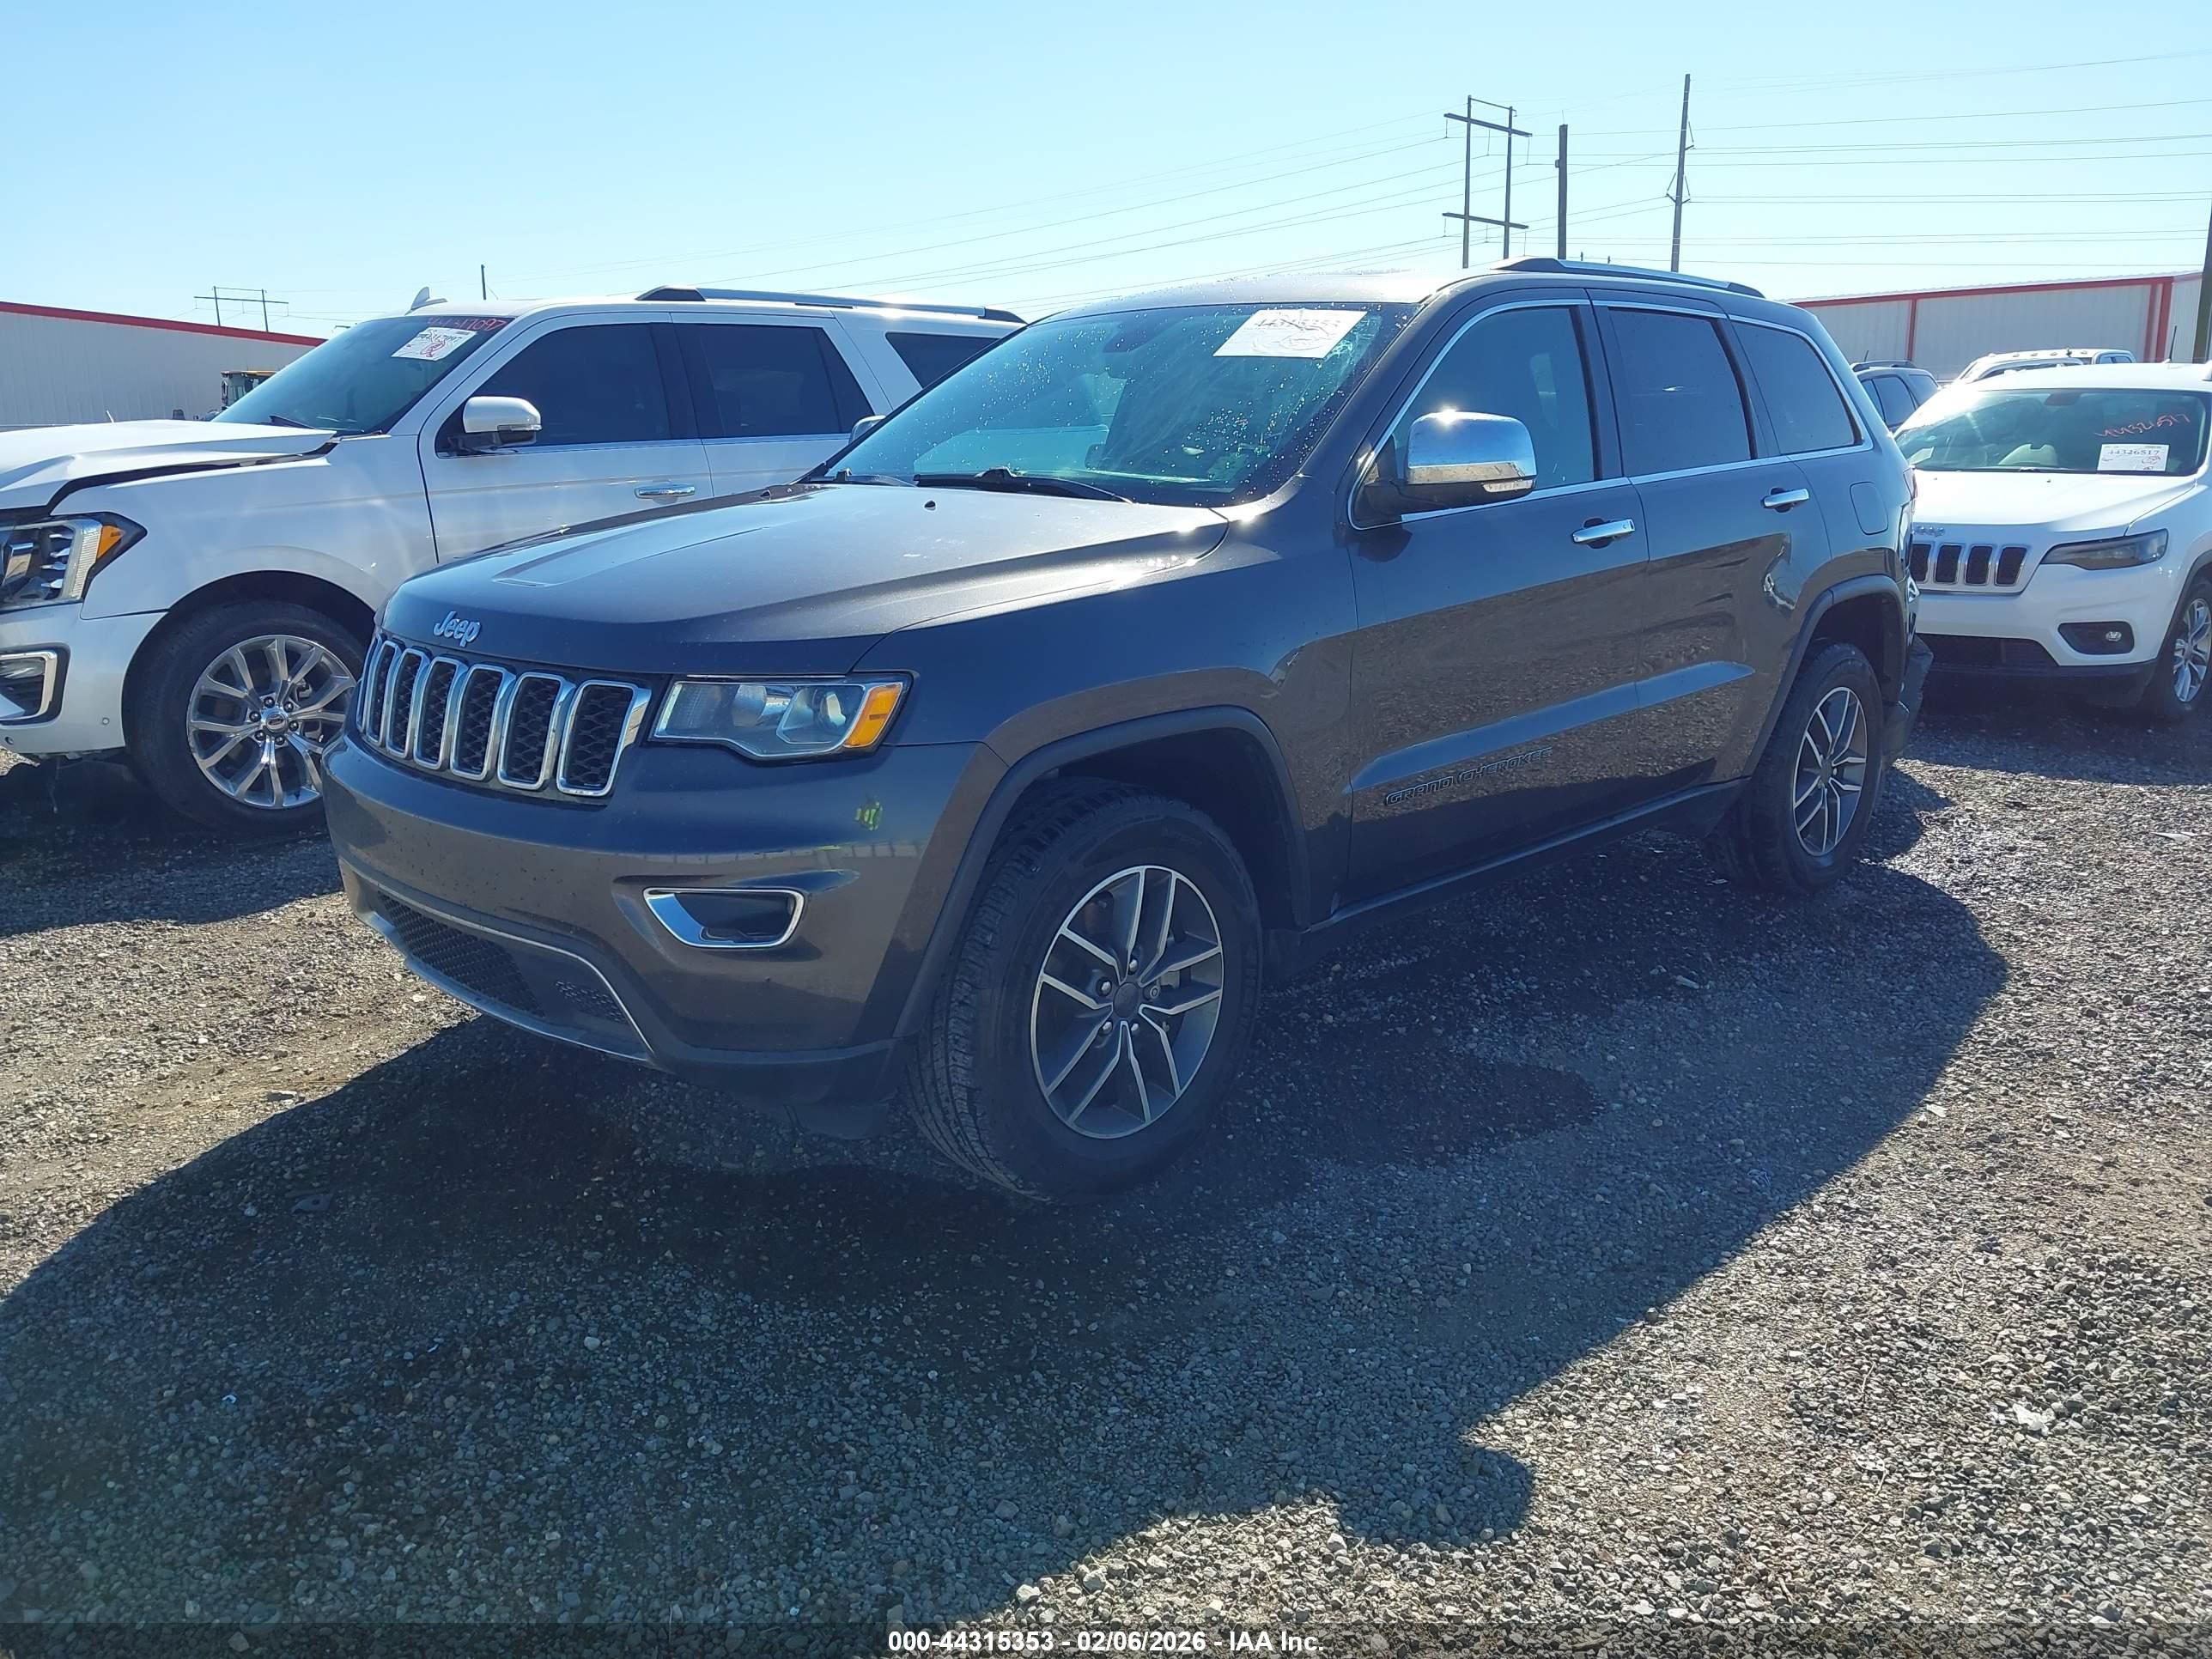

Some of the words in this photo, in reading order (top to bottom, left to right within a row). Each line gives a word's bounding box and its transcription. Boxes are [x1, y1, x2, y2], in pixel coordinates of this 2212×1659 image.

[433, 611, 481, 647] Jeep
[1385, 775, 1454, 806] GRAND
[1459, 746, 1553, 782] CHEROKEE
